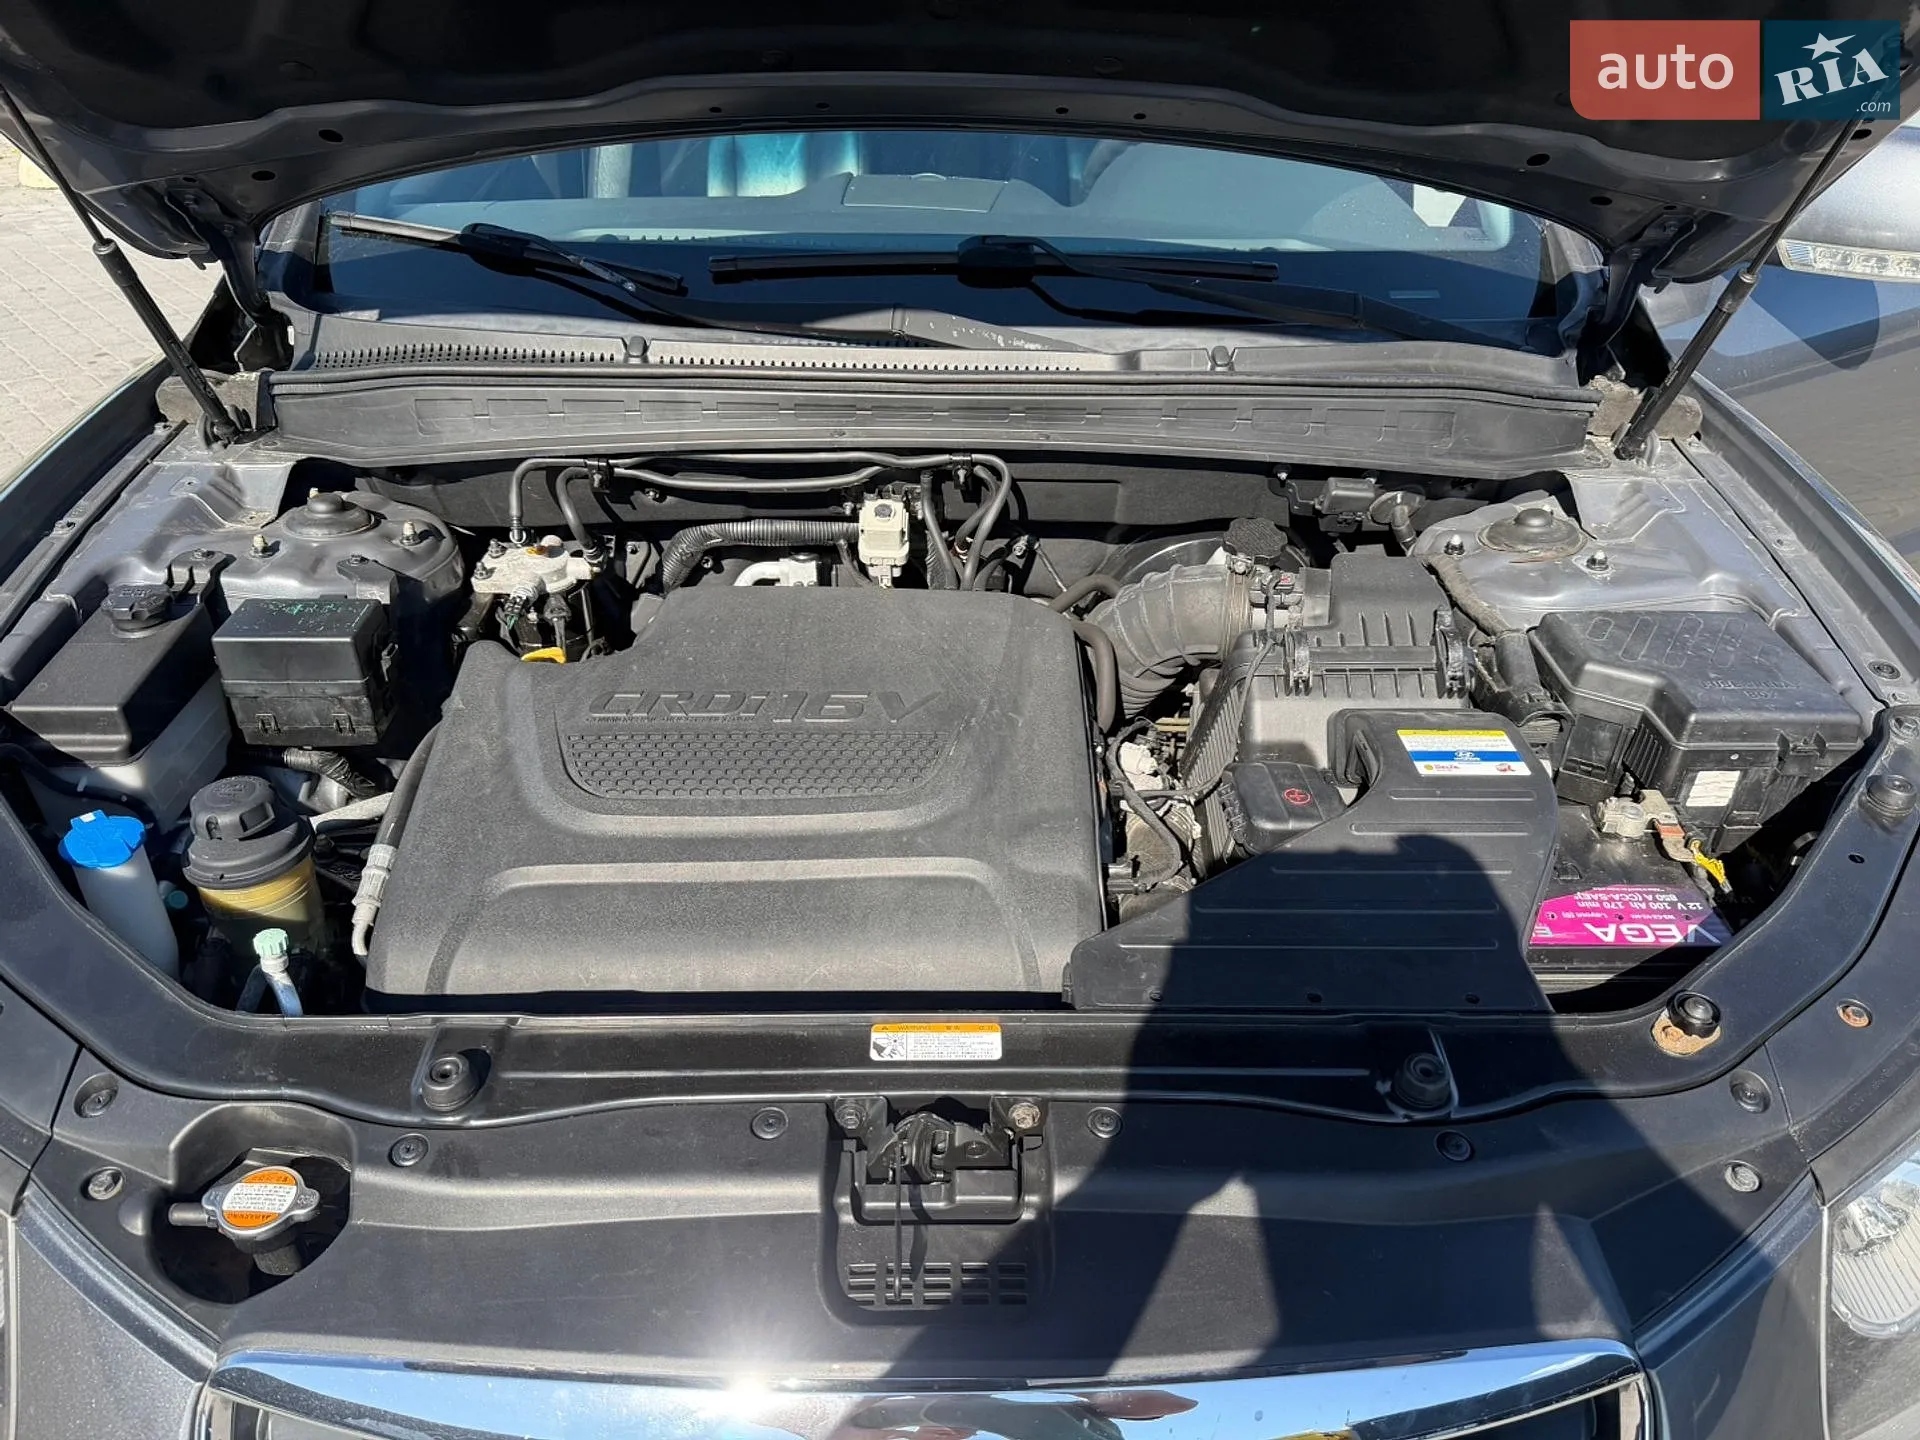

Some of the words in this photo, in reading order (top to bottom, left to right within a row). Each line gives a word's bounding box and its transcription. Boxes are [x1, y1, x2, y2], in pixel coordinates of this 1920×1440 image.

[1602, 901, 1625, 910] 170
[1629, 901, 1646, 910] Ah
[1649, 902, 1671, 910] 100
[1687, 902, 1703, 910] 12
[1583, 923, 1722, 944] VEGA
